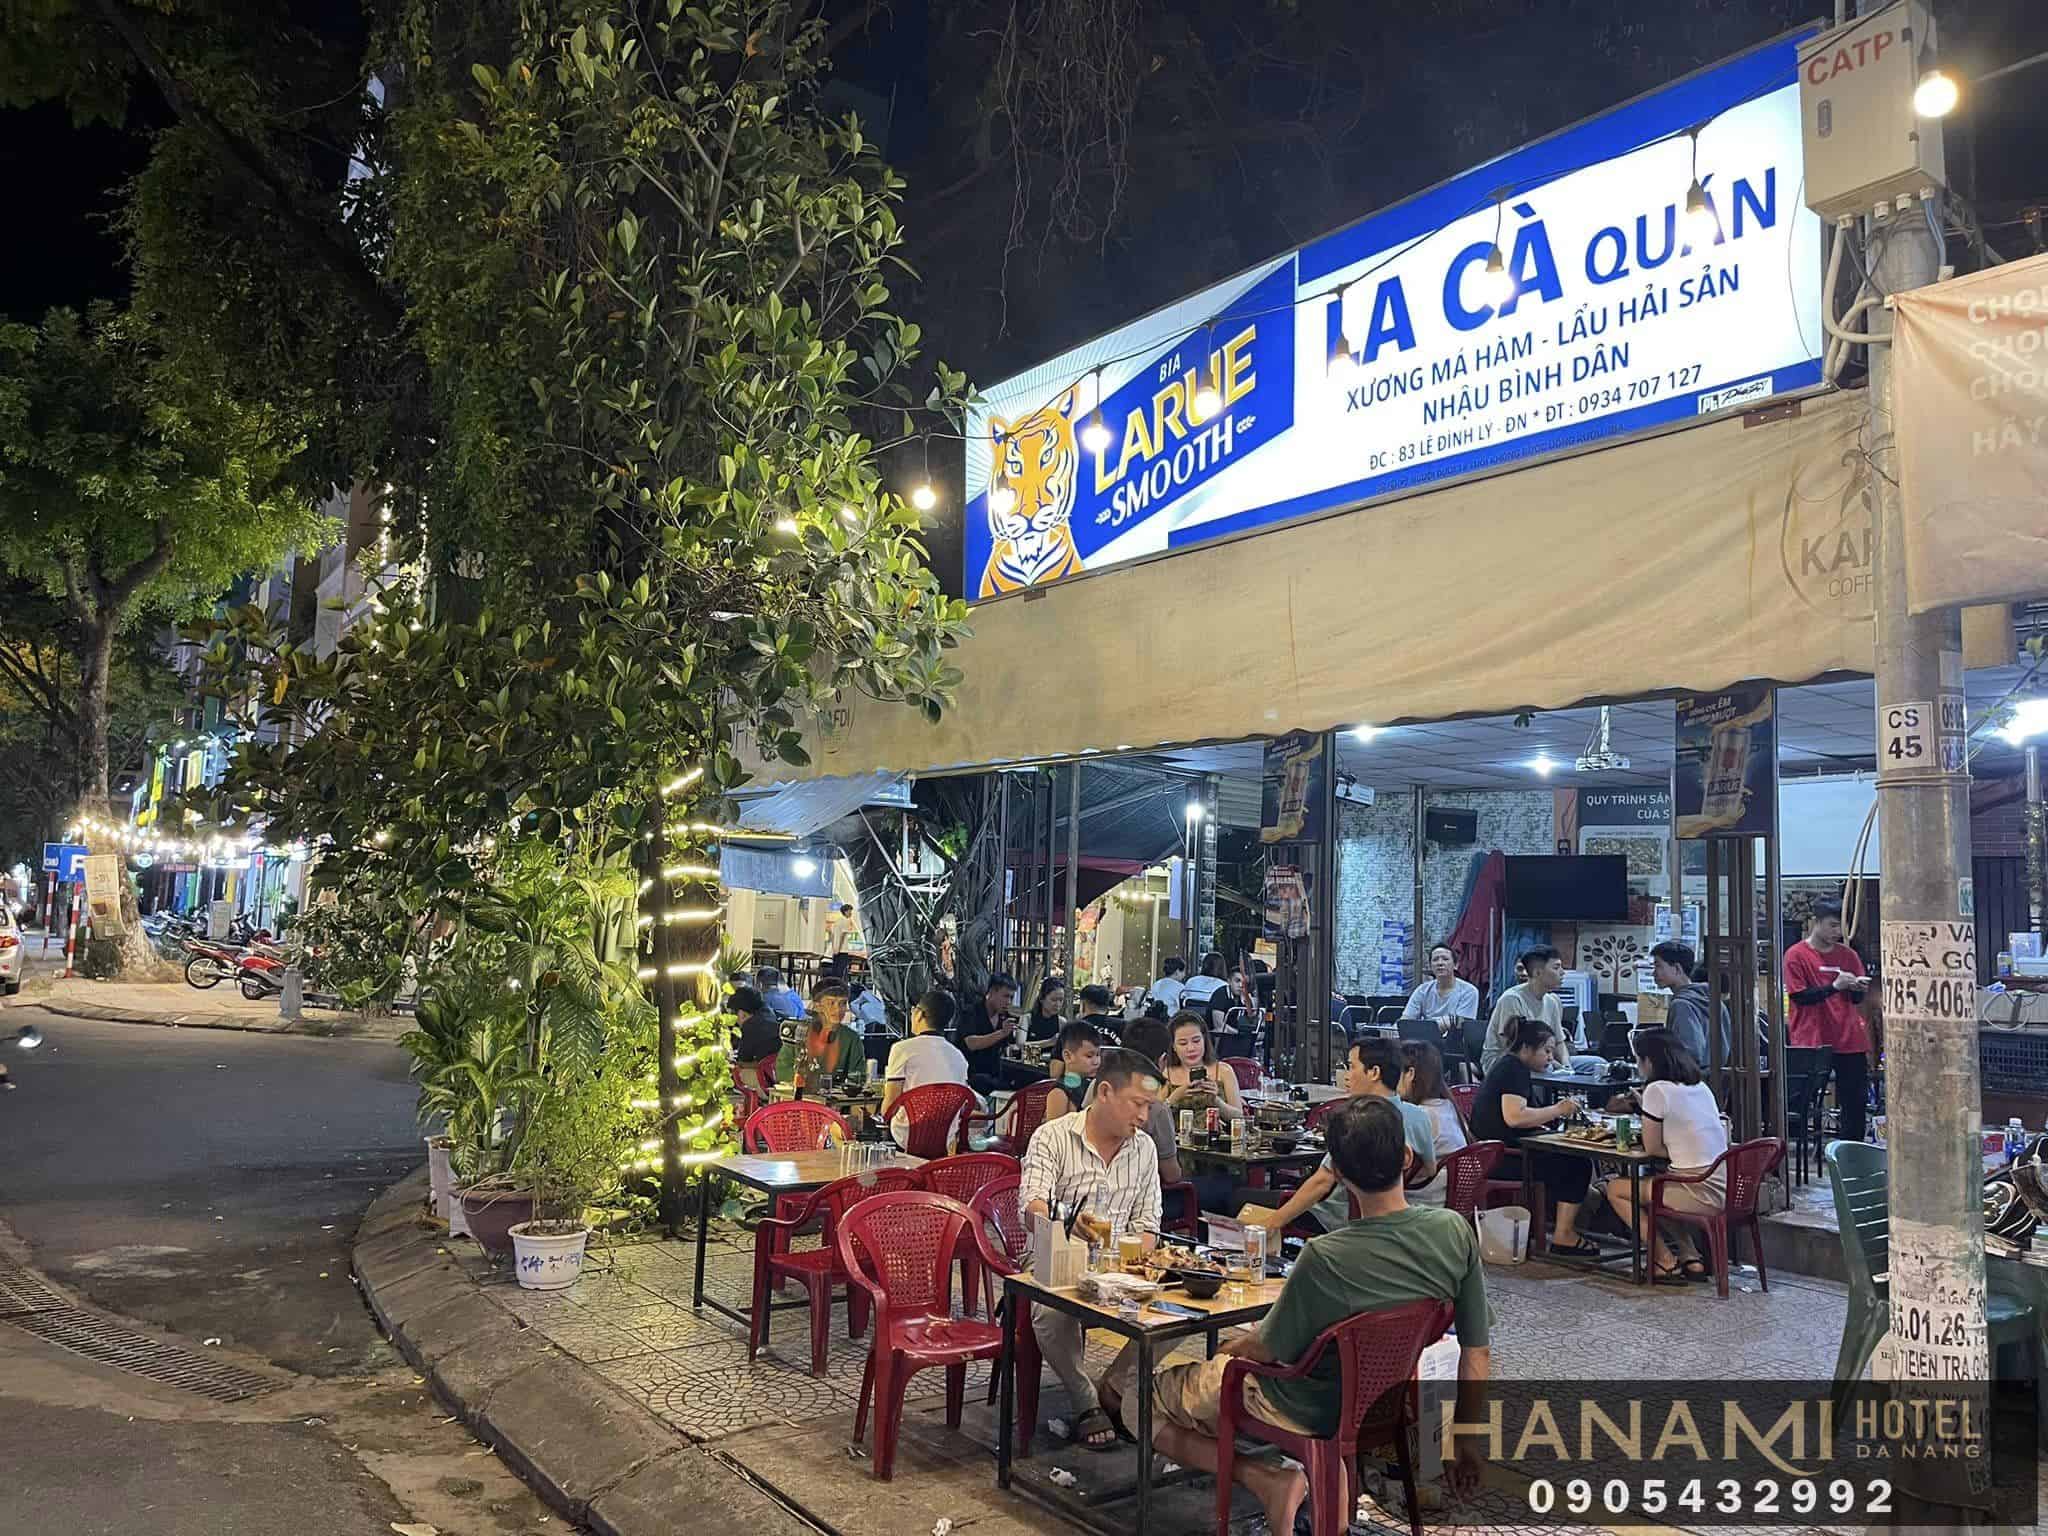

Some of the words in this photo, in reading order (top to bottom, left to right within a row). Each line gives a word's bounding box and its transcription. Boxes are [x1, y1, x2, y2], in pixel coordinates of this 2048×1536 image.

[1807, 31, 1893, 86] CATP
[1442, 203, 1563, 332] CÀ
[1584, 167, 1776, 285] QUÁN
[1158, 353, 1181, 384] BIA
[1346, 368, 1424, 412] XƯƠNG
[1431, 353, 1467, 391] MÁ
[1475, 332, 1533, 376] HÀM
[1558, 303, 1608, 345] LẨU
[1619, 281, 1668, 325] HẢI
[1679, 264, 1740, 308] SẢN
[1094, 323, 1257, 497] LARUE
[1399, 443, 1415, 462] 83
[1420, 434, 1433, 456] LÊ
[1506, 413, 1528, 433] ĐN
[1546, 402, 1565, 423] ĐT
[1578, 386, 1622, 415] 0934
[1628, 375, 1661, 402] 707
[1667, 364, 1702, 390] 127
[1423, 381, 1489, 424] NHẬU
[1499, 362, 1562, 402] BÌNH
[1573, 342, 1630, 383] DÂN
[1112, 415, 1234, 528] SMOOTH
[1888, 709, 1919, 730] CS
[1888, 735, 1923, 760] 45
[1586, 794, 1608, 806] QUY
[1612, 792, 1646, 805] TRÌNH
[1637, 807, 1660, 819] CỦA
